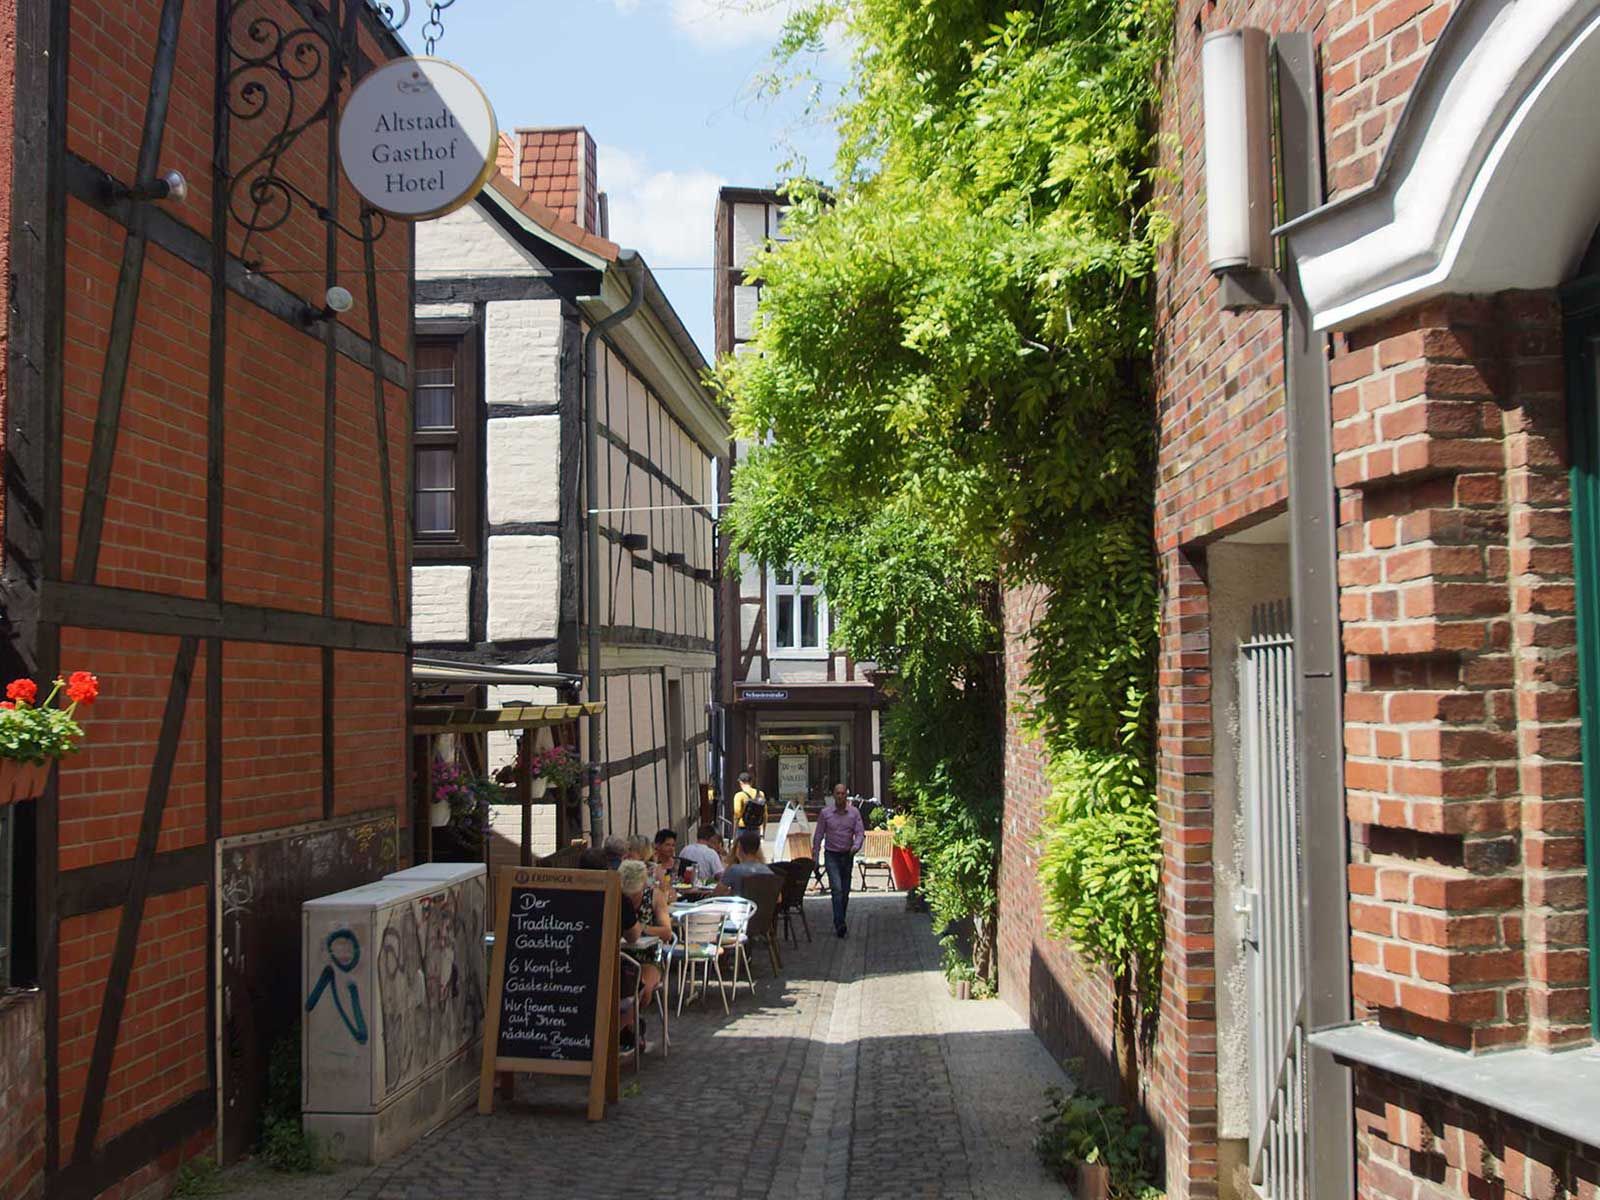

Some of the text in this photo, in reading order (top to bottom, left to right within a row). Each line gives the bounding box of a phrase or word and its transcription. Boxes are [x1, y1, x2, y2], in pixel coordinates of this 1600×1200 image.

[374, 108, 456, 133] Altstadt
[371, 137, 458, 164] Gasthof
[384, 169, 445, 193] Hotel
[519, 892, 551, 911] Der
[511, 913, 591, 932] Traditions-
[514, 934, 574, 955] Gasthof
[508, 957, 573, 979] 6 Komfort
[505, 976, 587, 994] Gästezimmer
[504, 997, 579, 1015] Wir freuen uns
[508, 1012, 531, 1026] auf
[501, 1026, 592, 1048] nächsten Besuch
